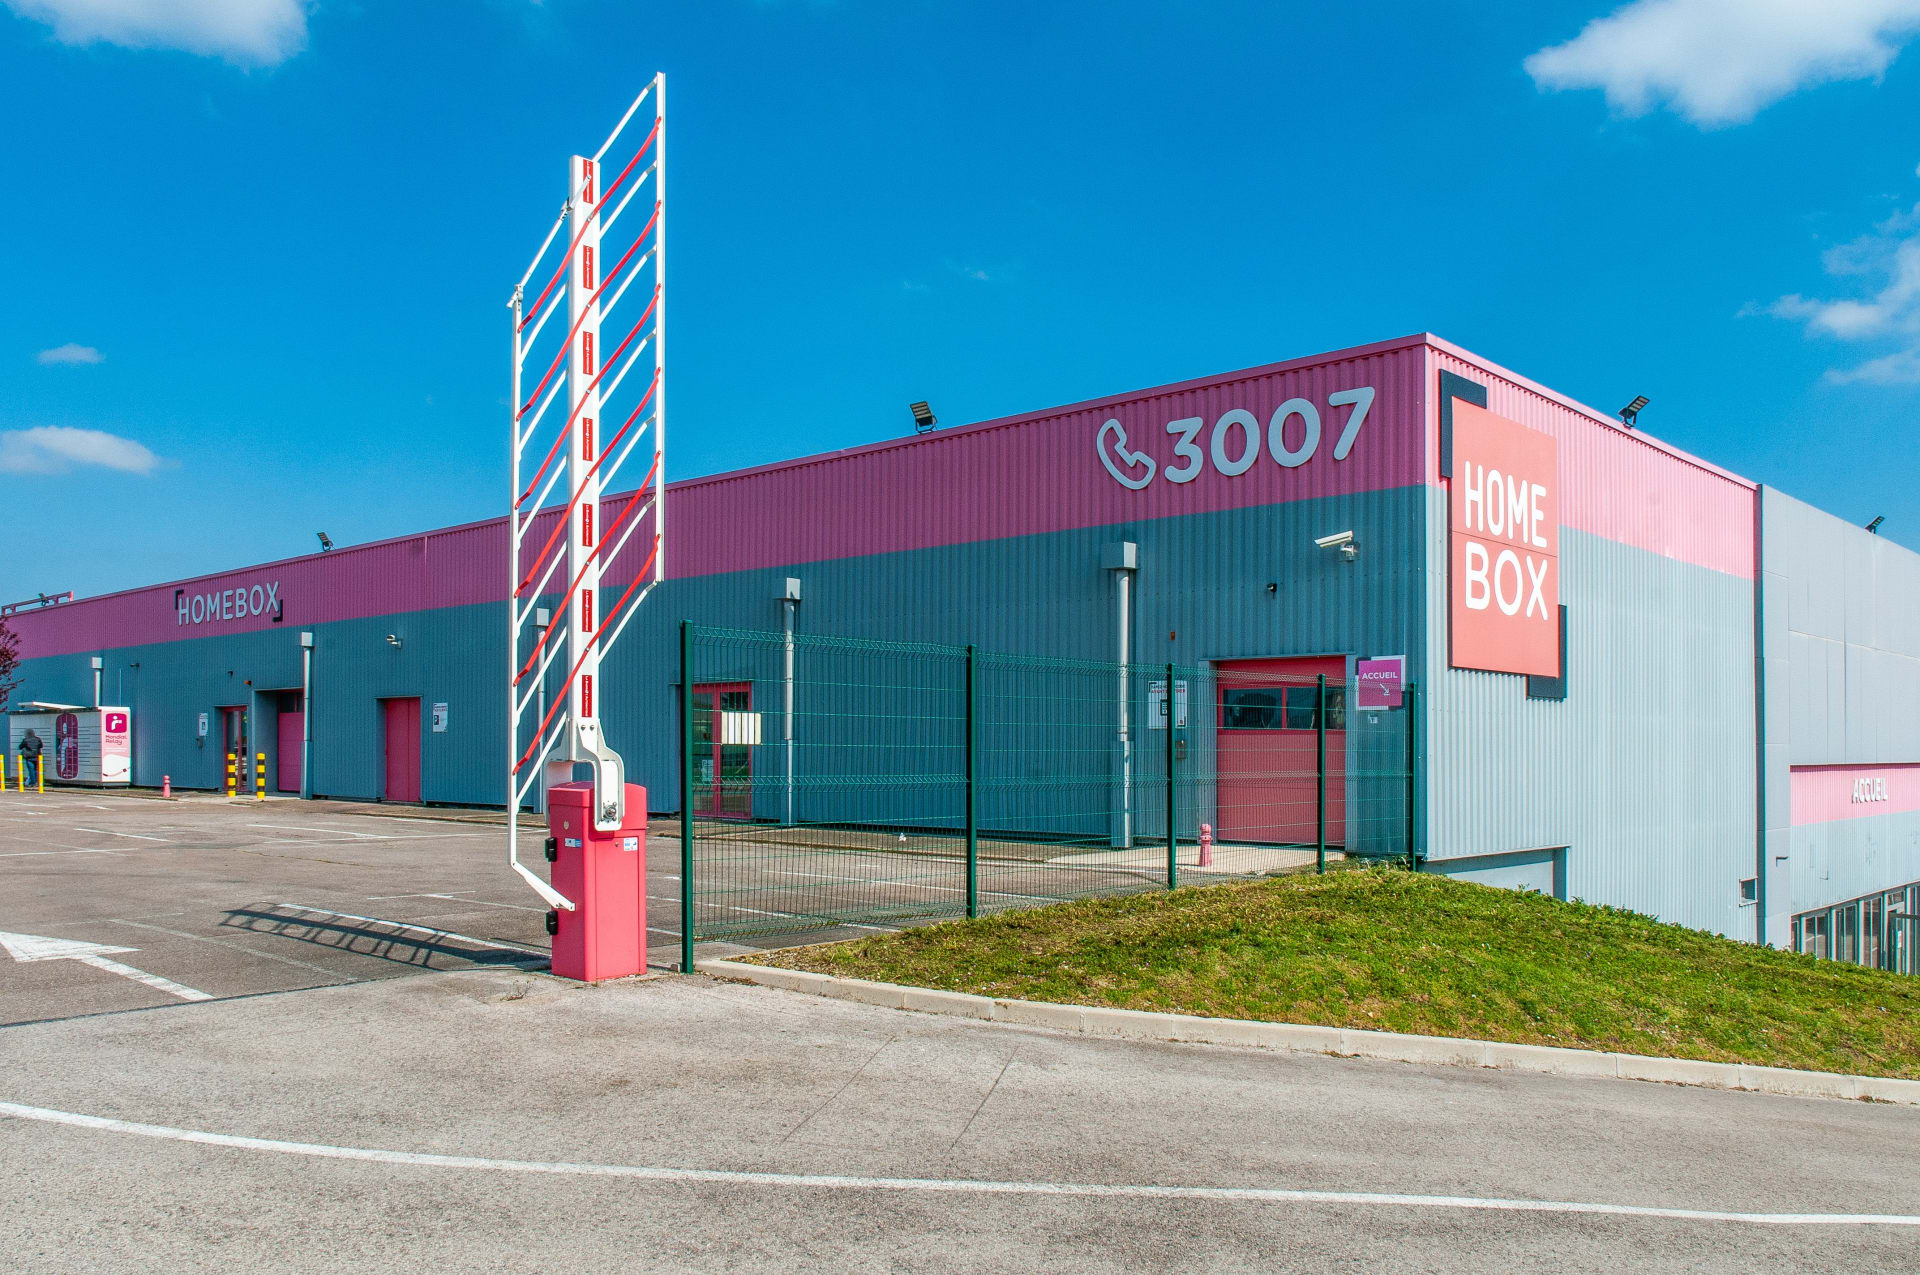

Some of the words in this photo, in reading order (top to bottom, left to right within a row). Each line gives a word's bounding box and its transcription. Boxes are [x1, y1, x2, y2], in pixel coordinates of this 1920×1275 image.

[1164, 386, 1375, 484] 3007
[1464, 460, 1548, 548] HOME
[178, 580, 280, 627] HOMEBOX
[1465, 541, 1549, 621] BOX
[1361, 671, 1398, 680] ACCUEIL
[105, 738, 123, 746] Relay
[1852, 778, 1889, 804] ACCUEIL
